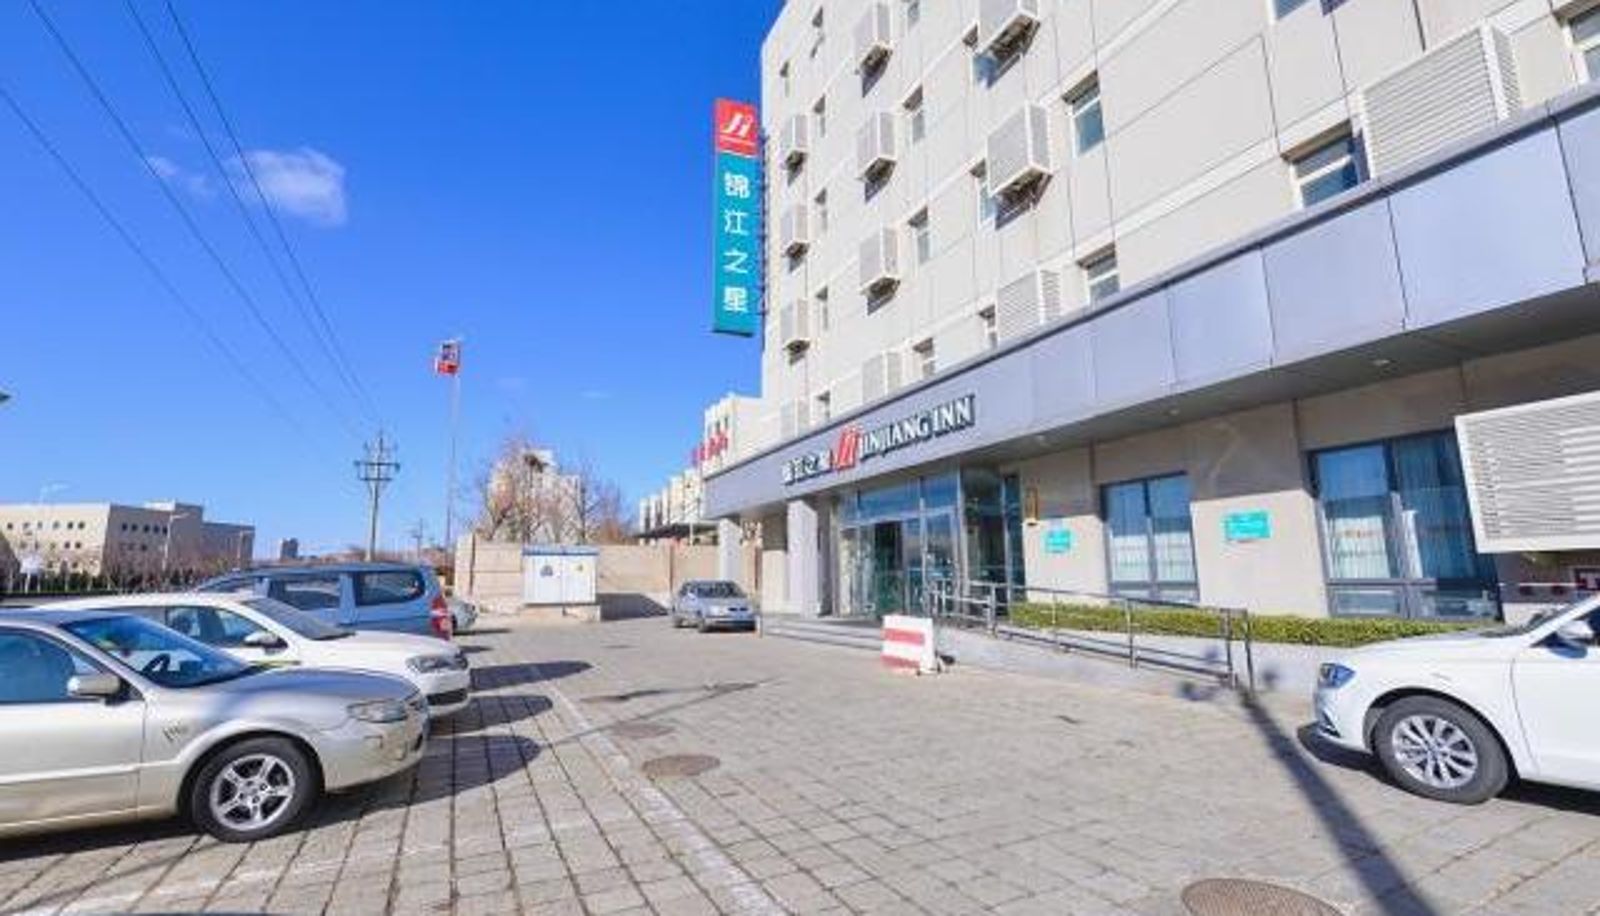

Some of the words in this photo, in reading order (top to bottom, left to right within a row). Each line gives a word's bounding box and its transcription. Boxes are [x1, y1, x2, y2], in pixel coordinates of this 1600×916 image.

[723, 172, 750, 314] 锦江之星
[932, 396, 975, 432] INN
